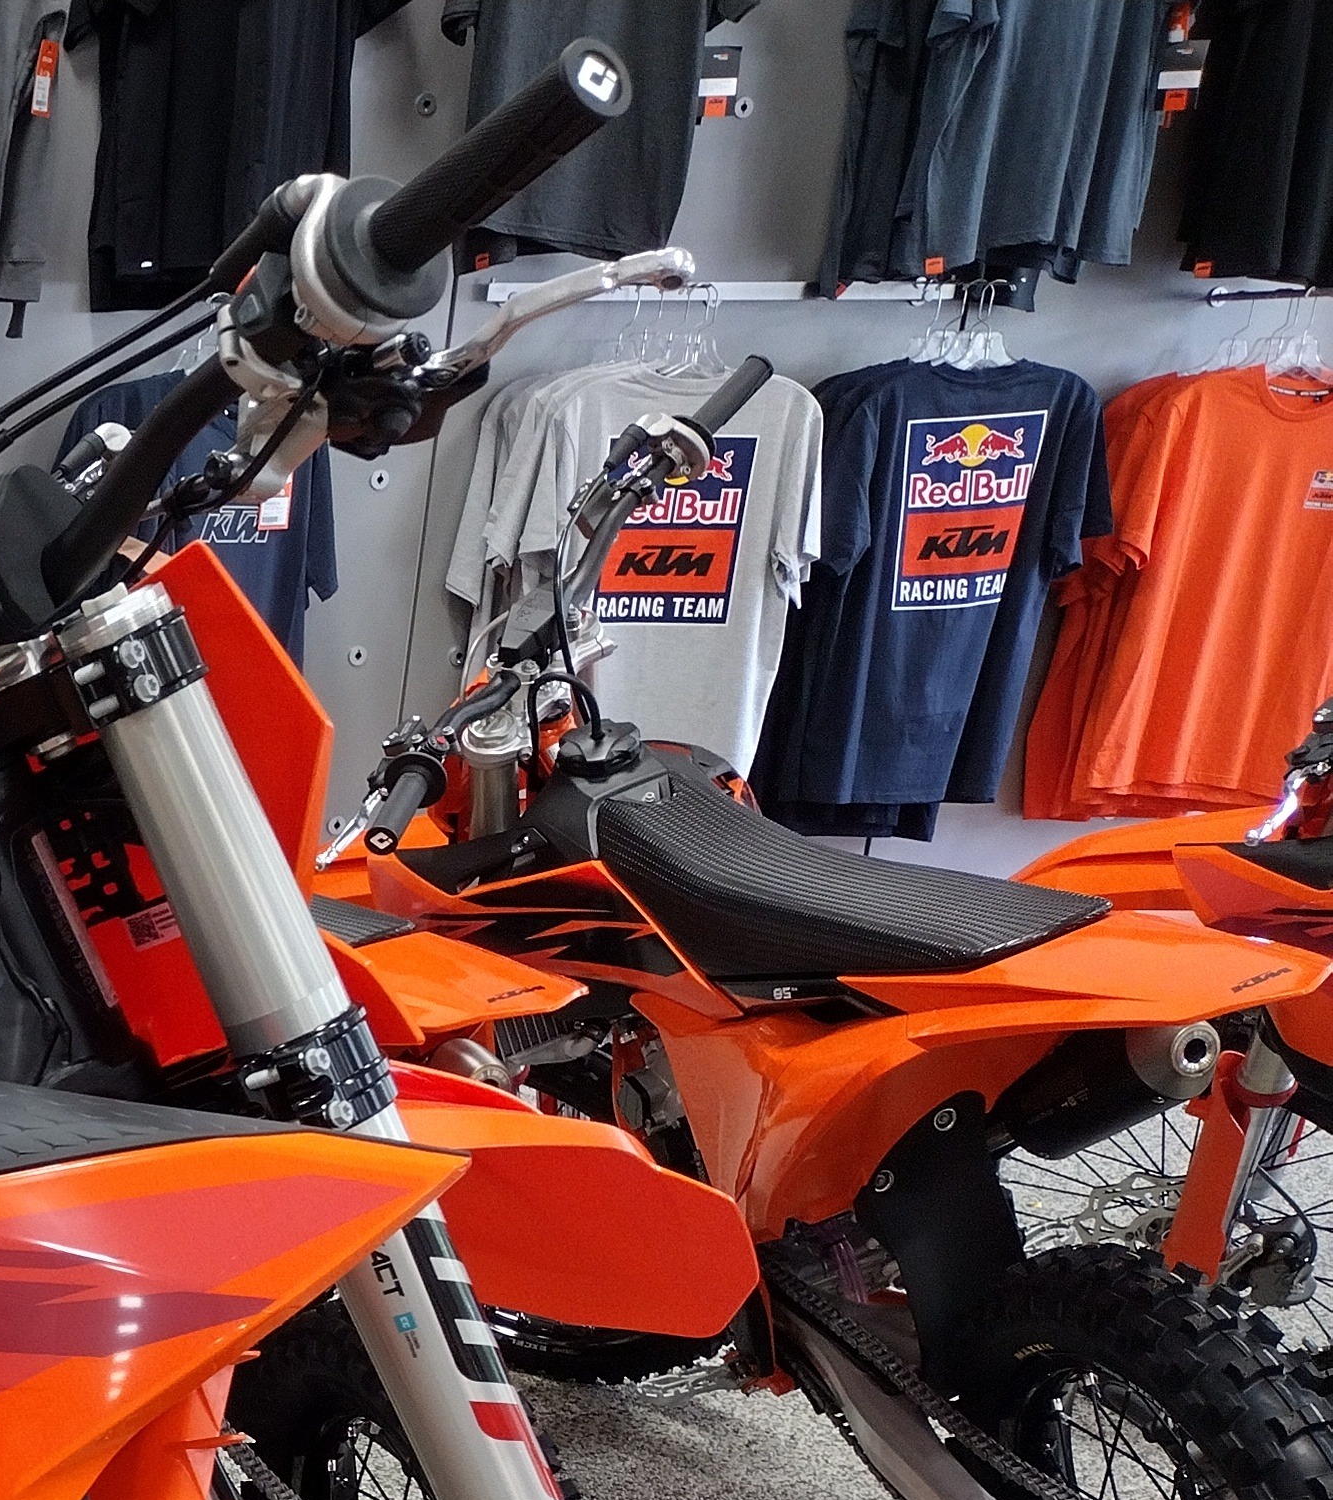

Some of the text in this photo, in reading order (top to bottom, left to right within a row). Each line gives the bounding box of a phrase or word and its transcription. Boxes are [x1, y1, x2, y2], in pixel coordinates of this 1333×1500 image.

[908, 463, 1033, 508] Red Bull
[628, 487, 743, 524] ed Bull
[917, 524, 1010, 561] KTM
[615, 545, 715, 576] KTM
[900, 578, 968, 602] RACING
[597, 597, 725, 619] RACING TEAM
[773, 986, 792, 1000] 85
[369, 1250, 406, 1298] ACT
